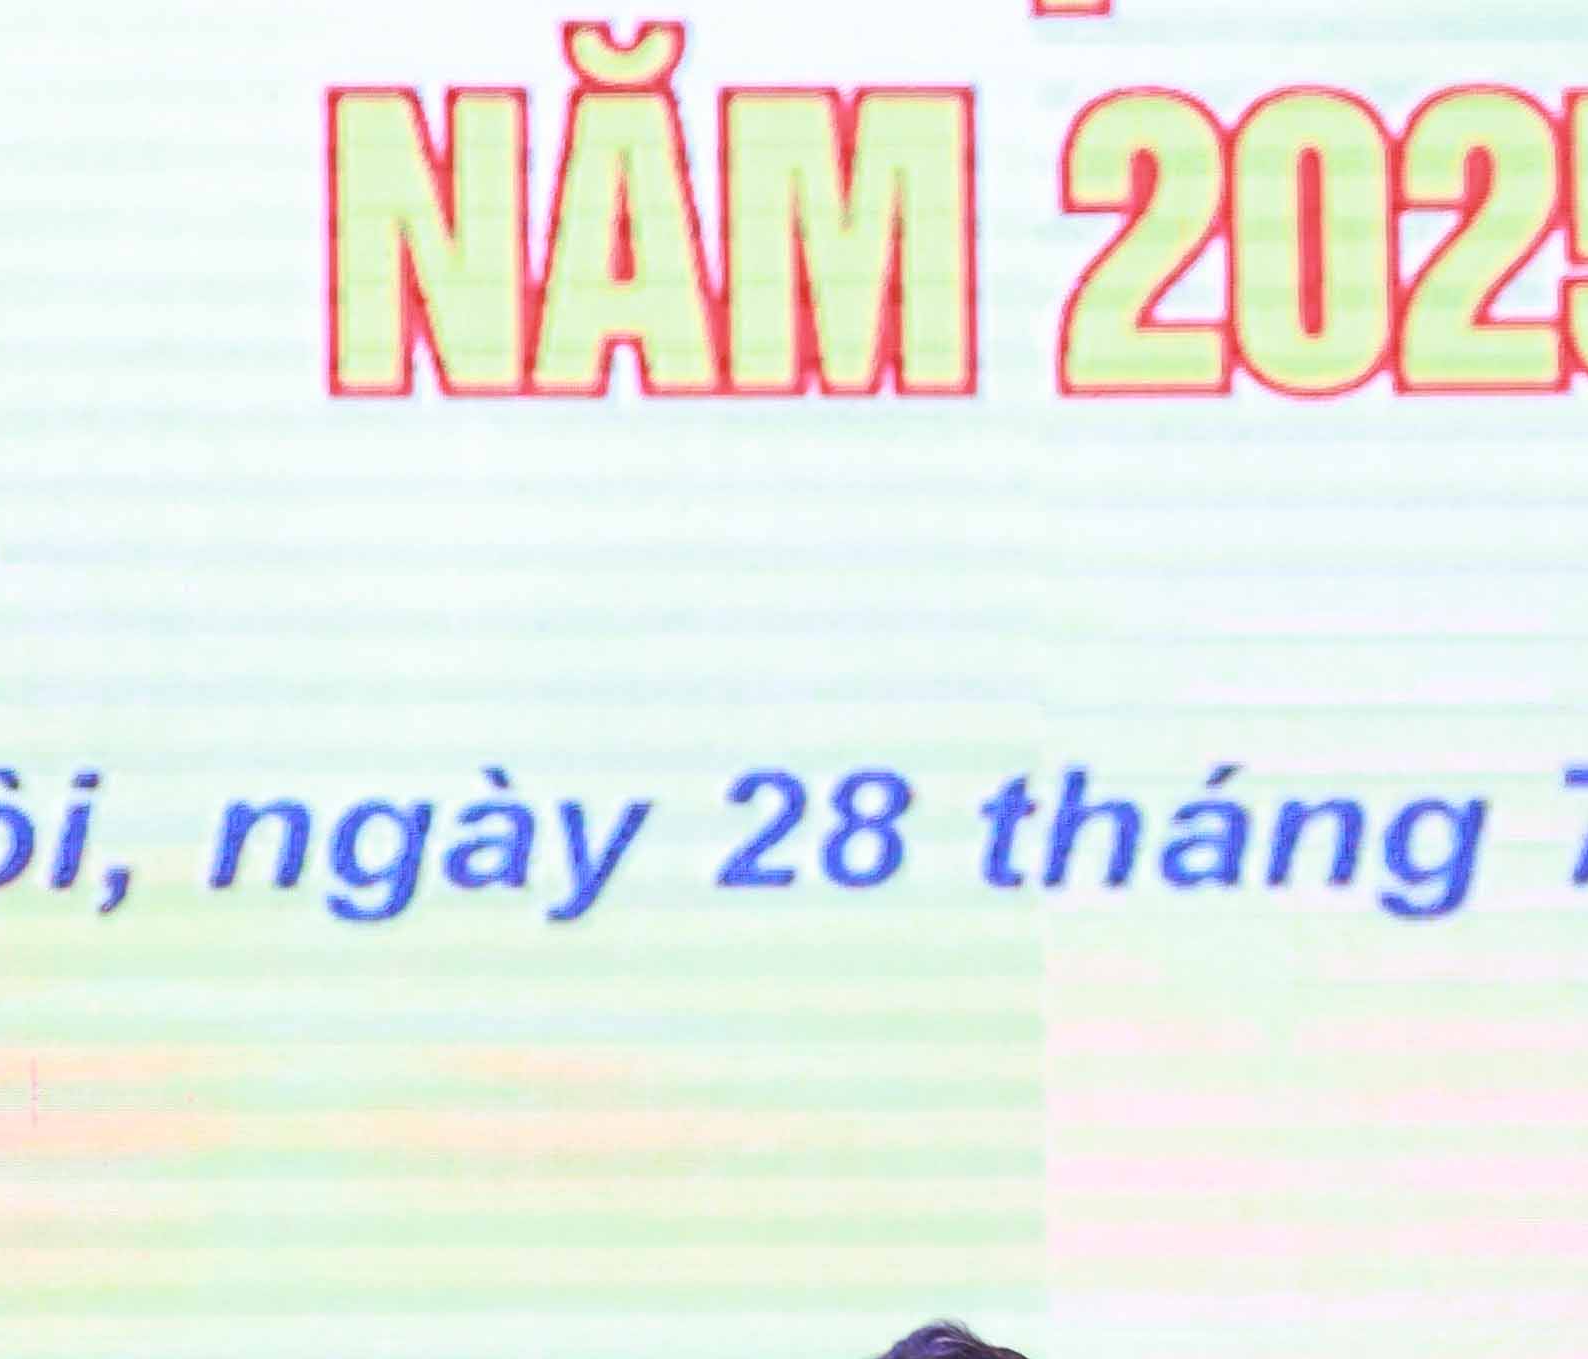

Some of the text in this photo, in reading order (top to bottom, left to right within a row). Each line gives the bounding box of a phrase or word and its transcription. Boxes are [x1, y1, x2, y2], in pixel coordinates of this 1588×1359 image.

[324, 20, 979, 399] NĂM
[209, 765, 652, 924] ngày
[717, 768, 912, 889] 28
[981, 764, 1488, 922] tháng
